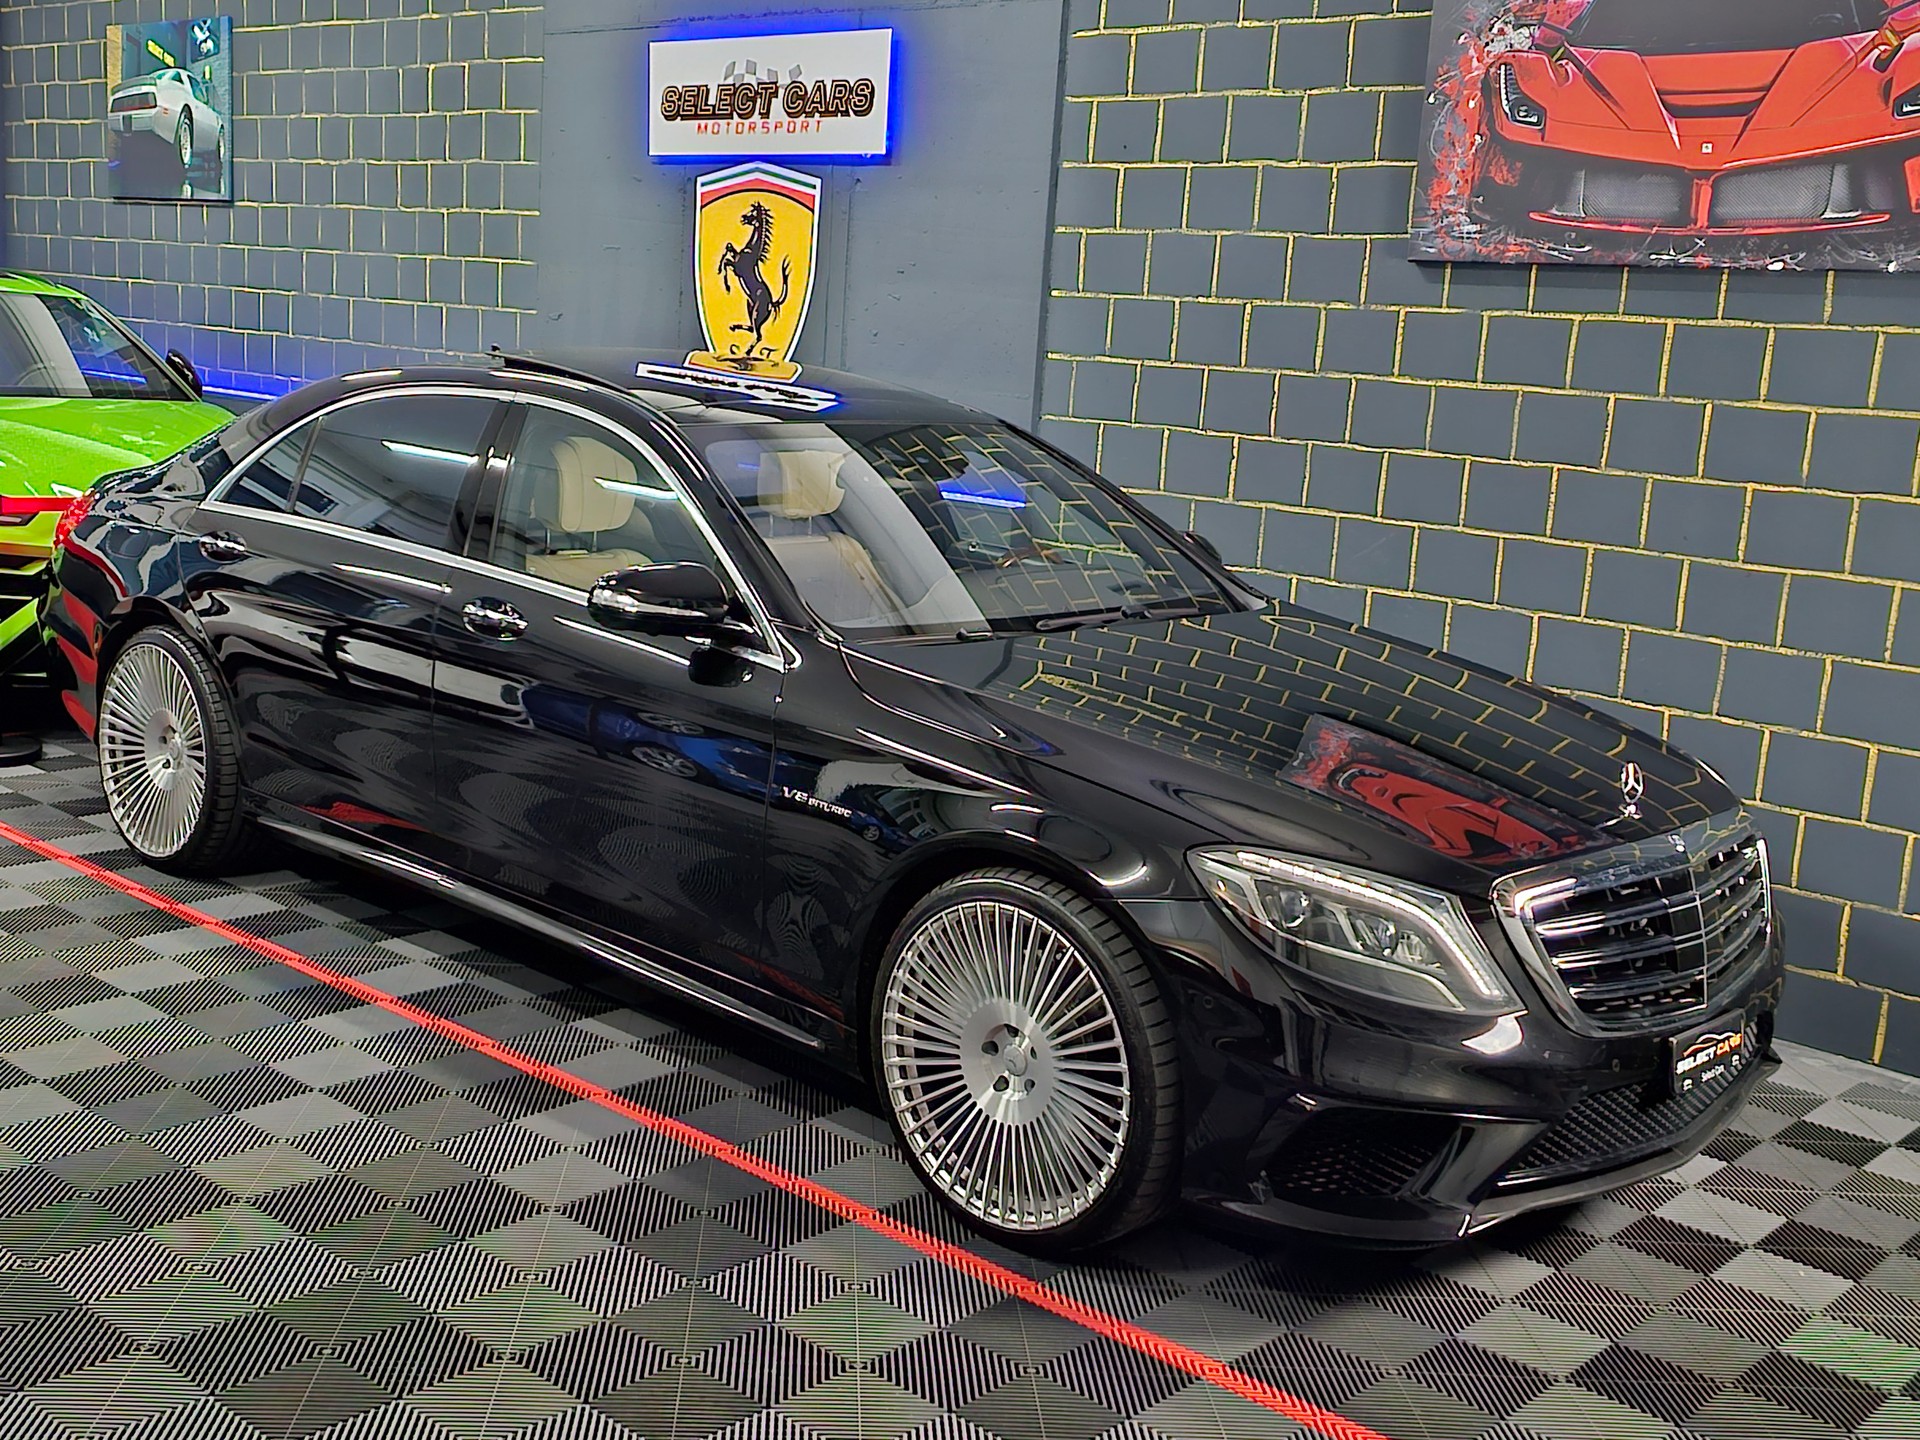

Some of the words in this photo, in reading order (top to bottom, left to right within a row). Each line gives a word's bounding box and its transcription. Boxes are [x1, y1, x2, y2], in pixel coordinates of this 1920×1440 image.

[661, 82, 779, 121] SELECT
[783, 78, 875, 119] CARS
[697, 120, 823, 135] MOTORSPORT
